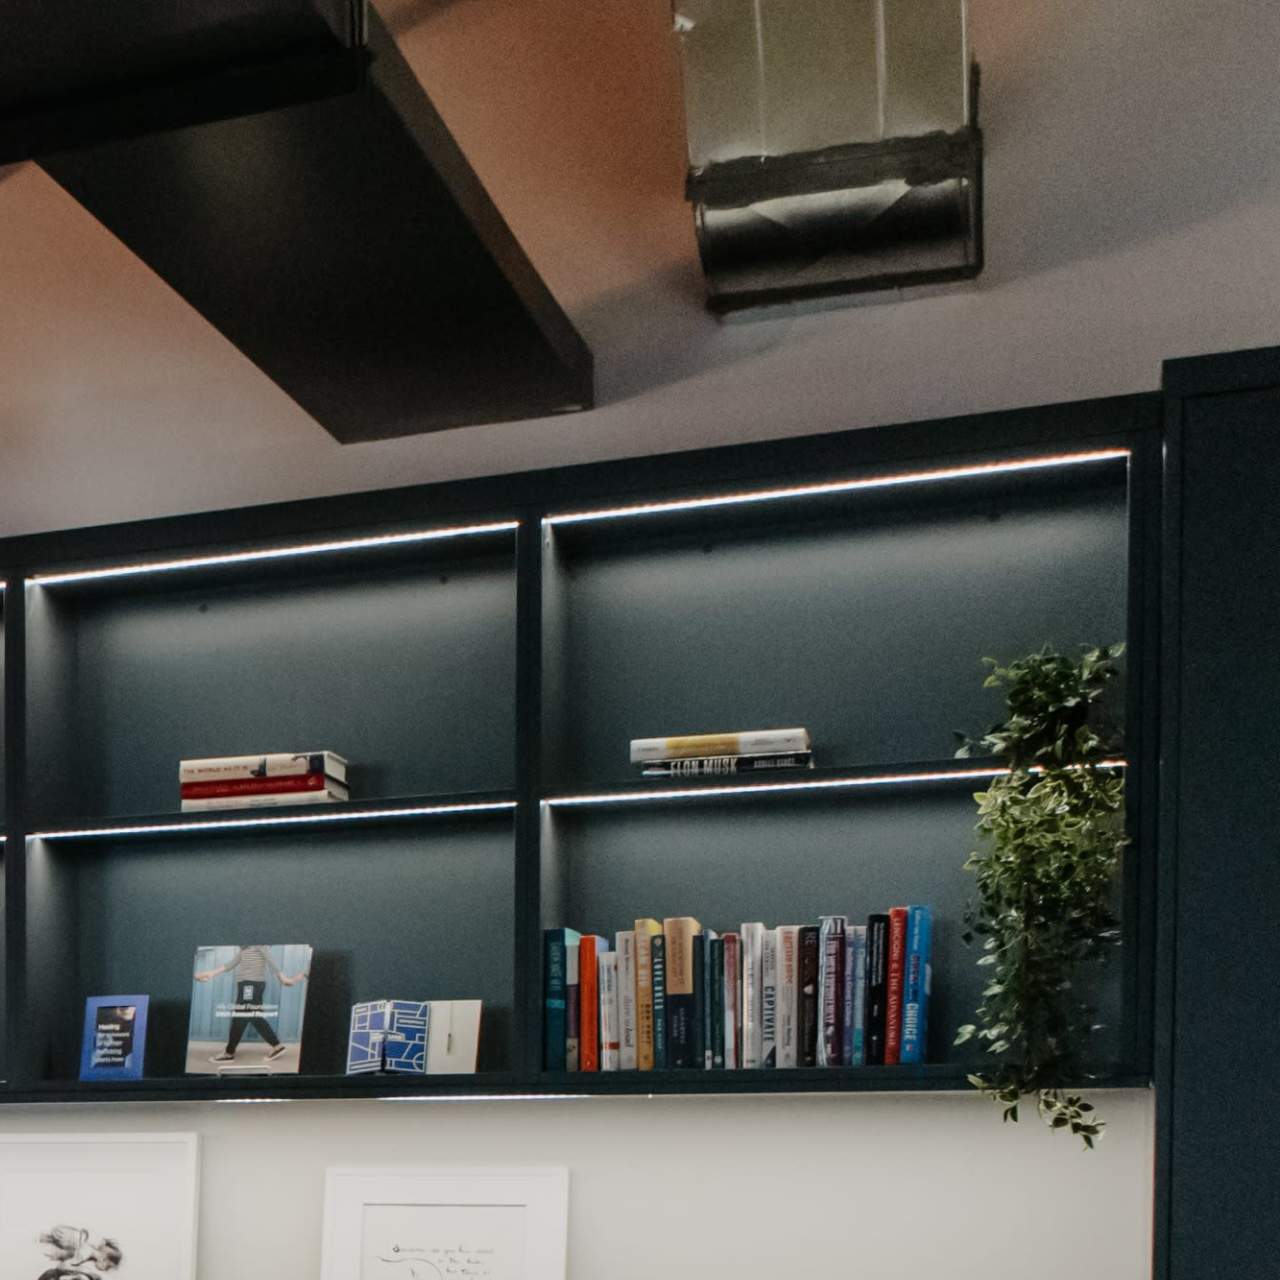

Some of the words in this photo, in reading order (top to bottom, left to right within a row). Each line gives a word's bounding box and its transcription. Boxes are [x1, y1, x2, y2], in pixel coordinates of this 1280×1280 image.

[671, 759, 700, 776] ELON
[704, 757, 737, 775] MUSK
[764, 985, 775, 1042] CAPTIVATE
[904, 1002, 919, 1041] CHOICE
